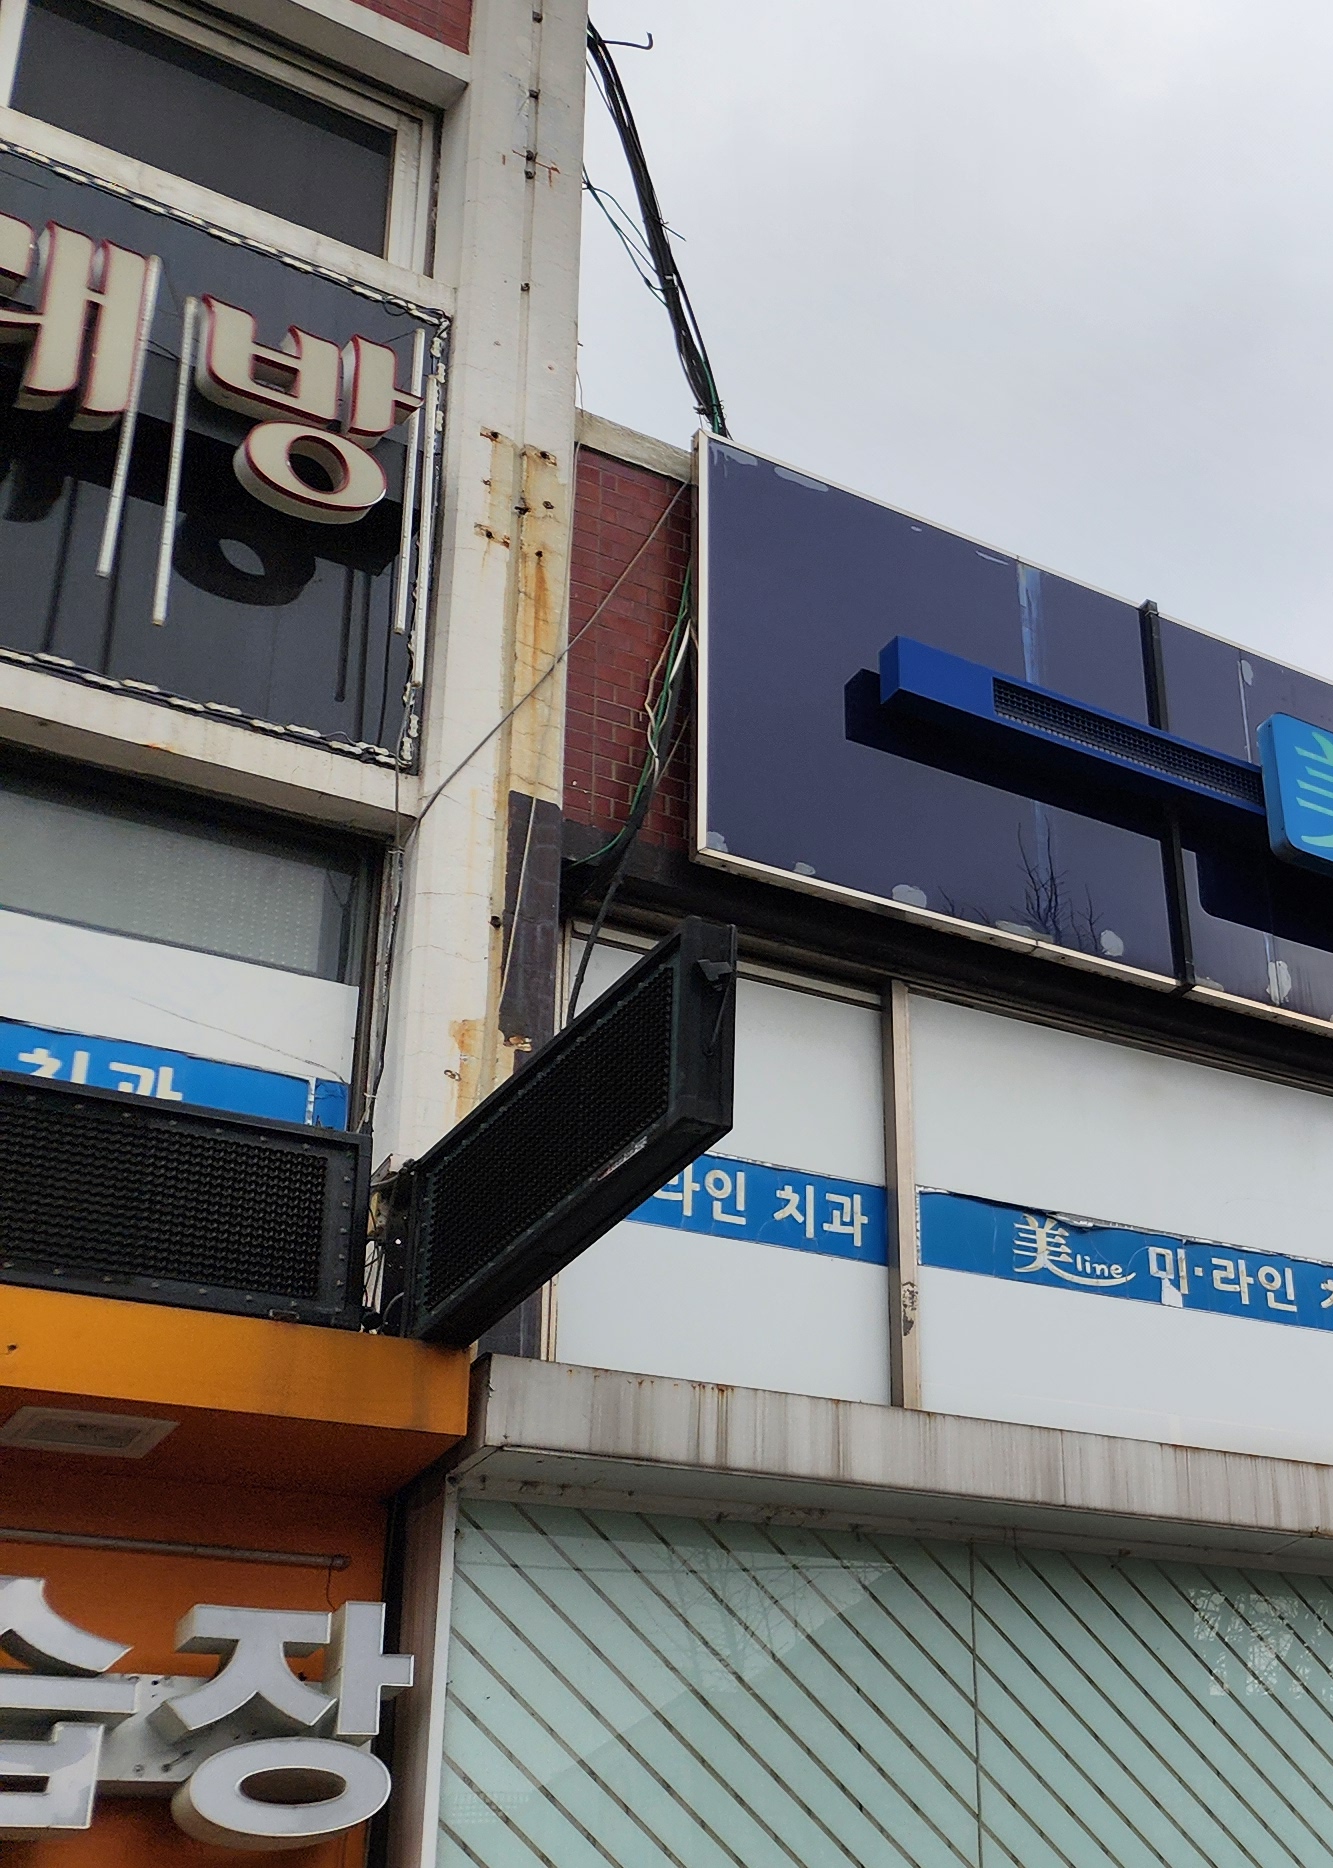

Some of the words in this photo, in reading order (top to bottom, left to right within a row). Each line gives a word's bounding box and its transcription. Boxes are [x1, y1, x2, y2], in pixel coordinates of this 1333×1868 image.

[773, 1184, 869, 1247] 치과
[1012, 1213, 1074, 1274] 美
[1076, 1254, 1123, 1279] line
